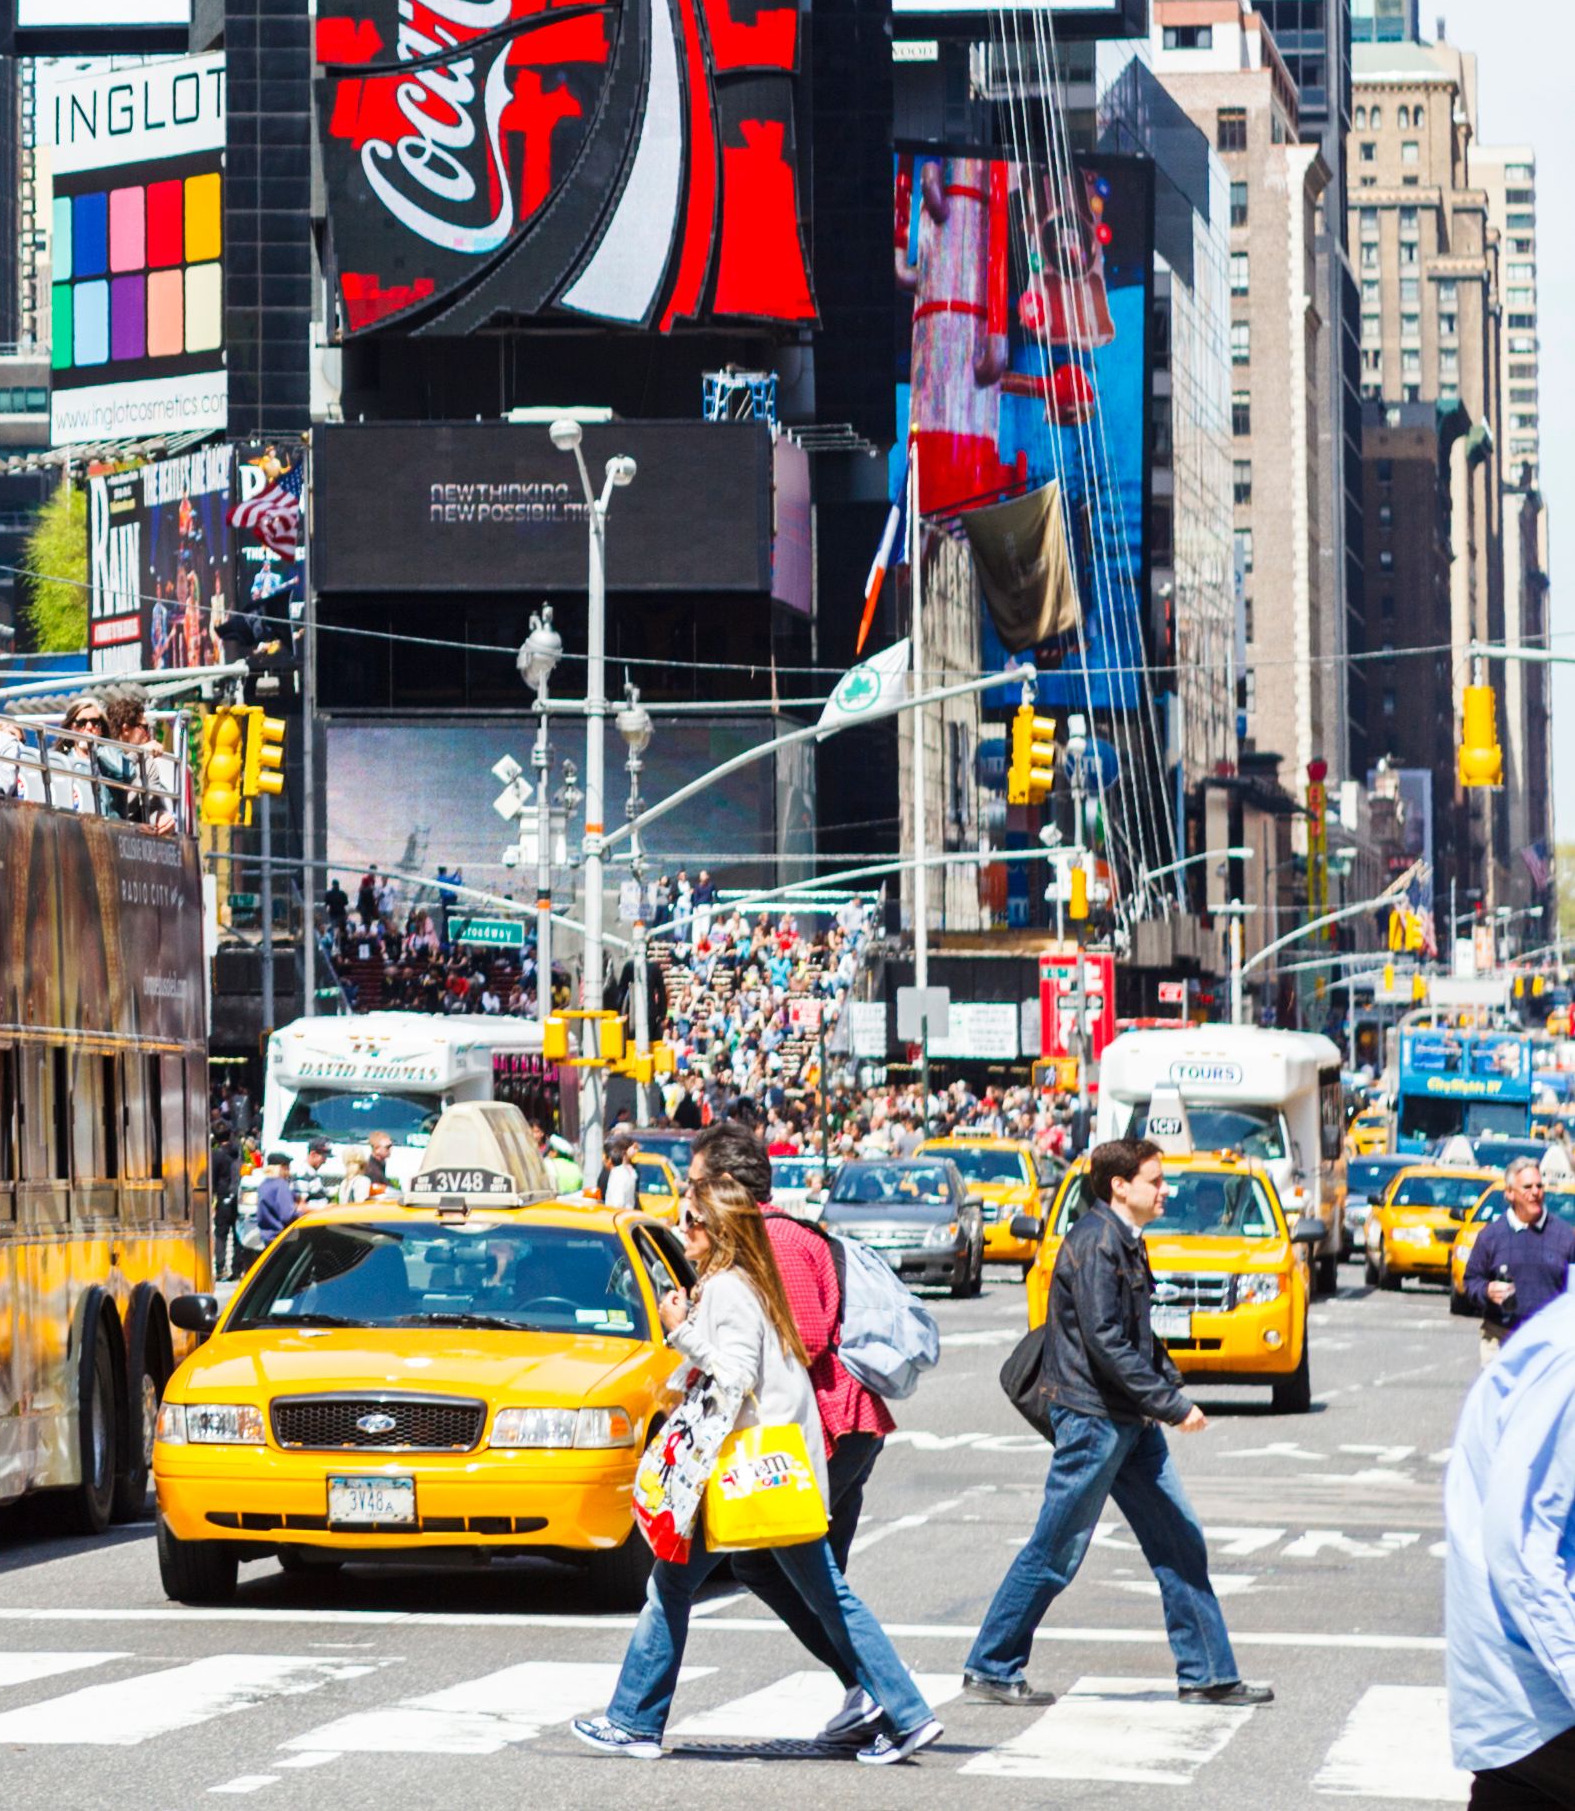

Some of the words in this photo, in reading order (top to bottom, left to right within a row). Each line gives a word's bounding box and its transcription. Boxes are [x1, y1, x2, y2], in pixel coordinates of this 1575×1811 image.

[54, 66, 227, 146] INGLOT
[298, 1061, 357, 1079] DAVID
[361, 1062, 440, 1081] THOMAS
[1177, 1066, 1235, 1080] TOURS
[436, 1171, 484, 1192] 3V48
